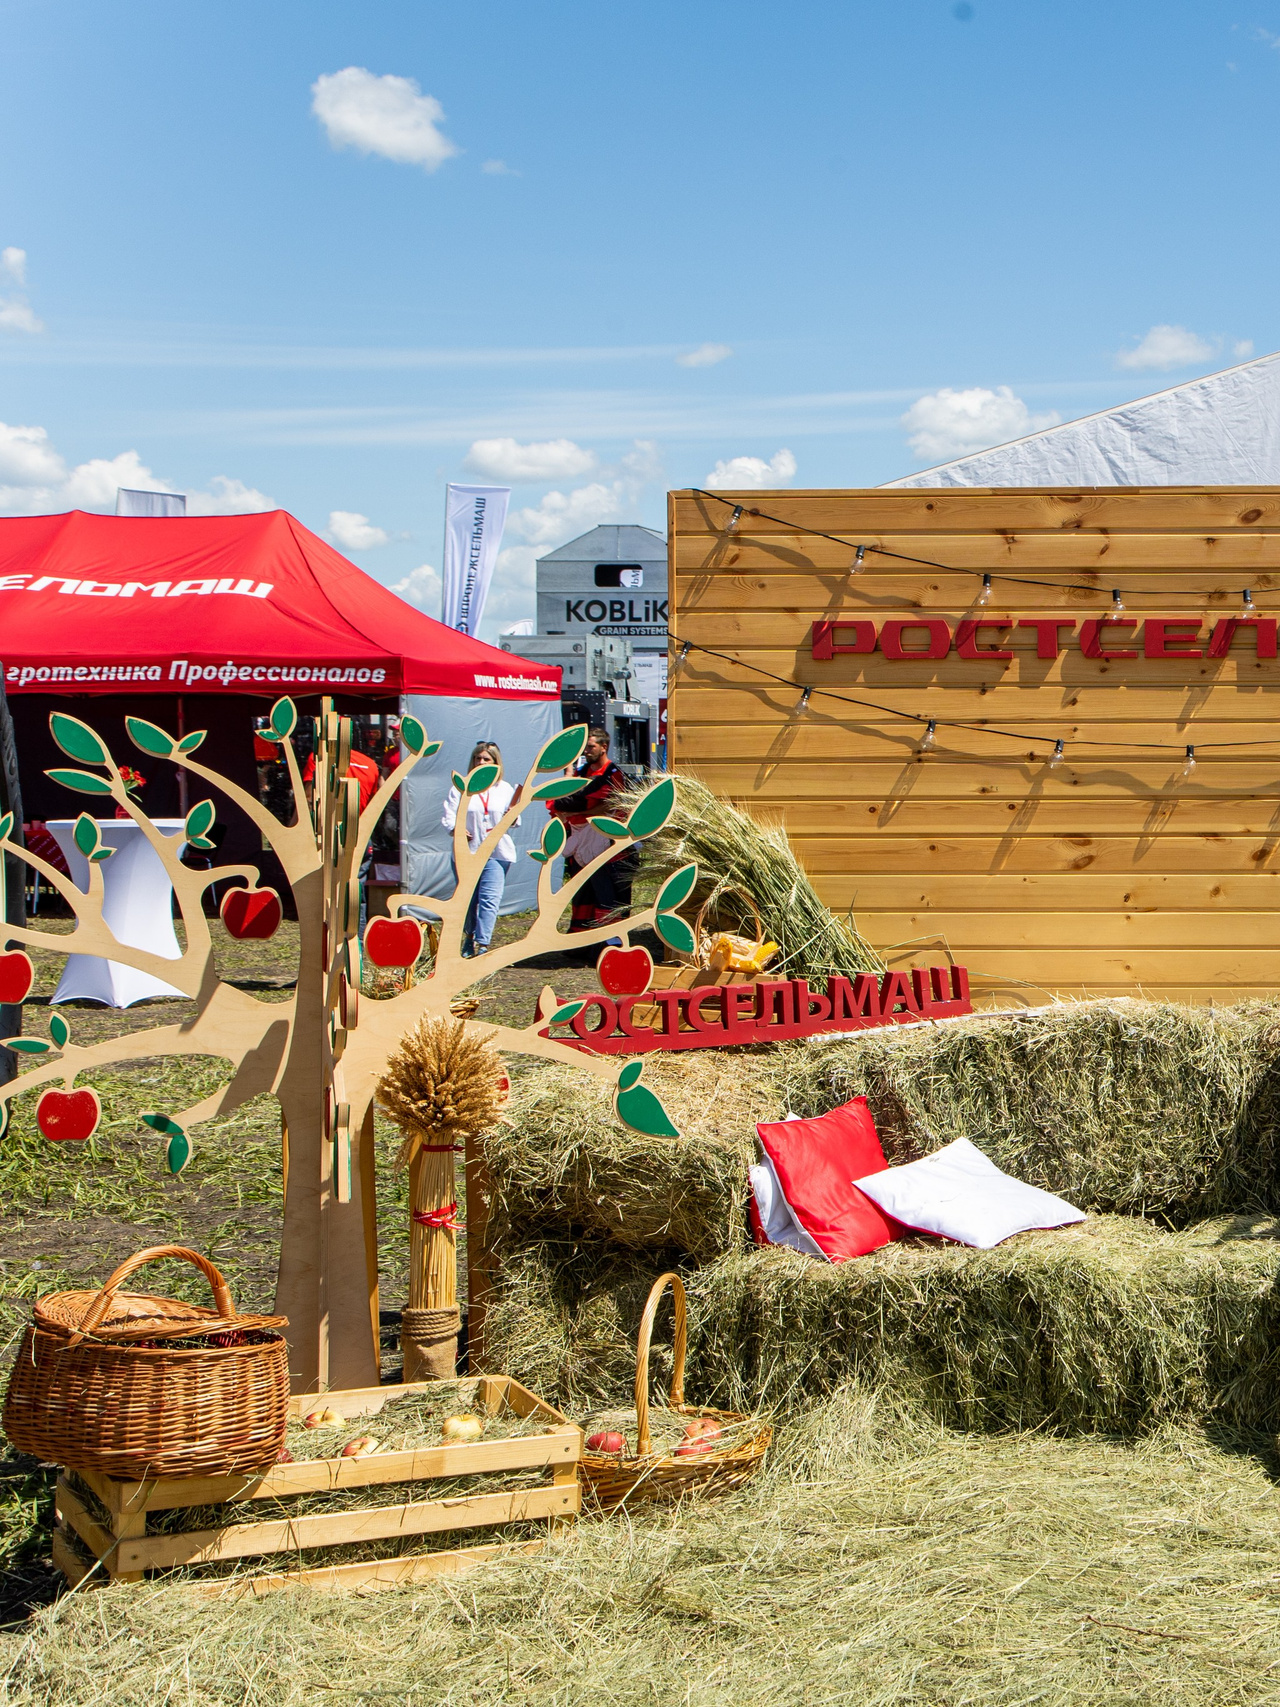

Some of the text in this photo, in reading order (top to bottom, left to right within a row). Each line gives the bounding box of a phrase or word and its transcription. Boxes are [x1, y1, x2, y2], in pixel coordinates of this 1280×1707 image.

[460, 497, 486, 619] ВОРОНЕЖСЕЛЬМАШ
[0, 574, 274, 598] ЕЛЬМАШ
[599, 626, 668, 635] GRAIN SYSTEMS
[6, 660, 387, 687] гротехника Профессионалов
